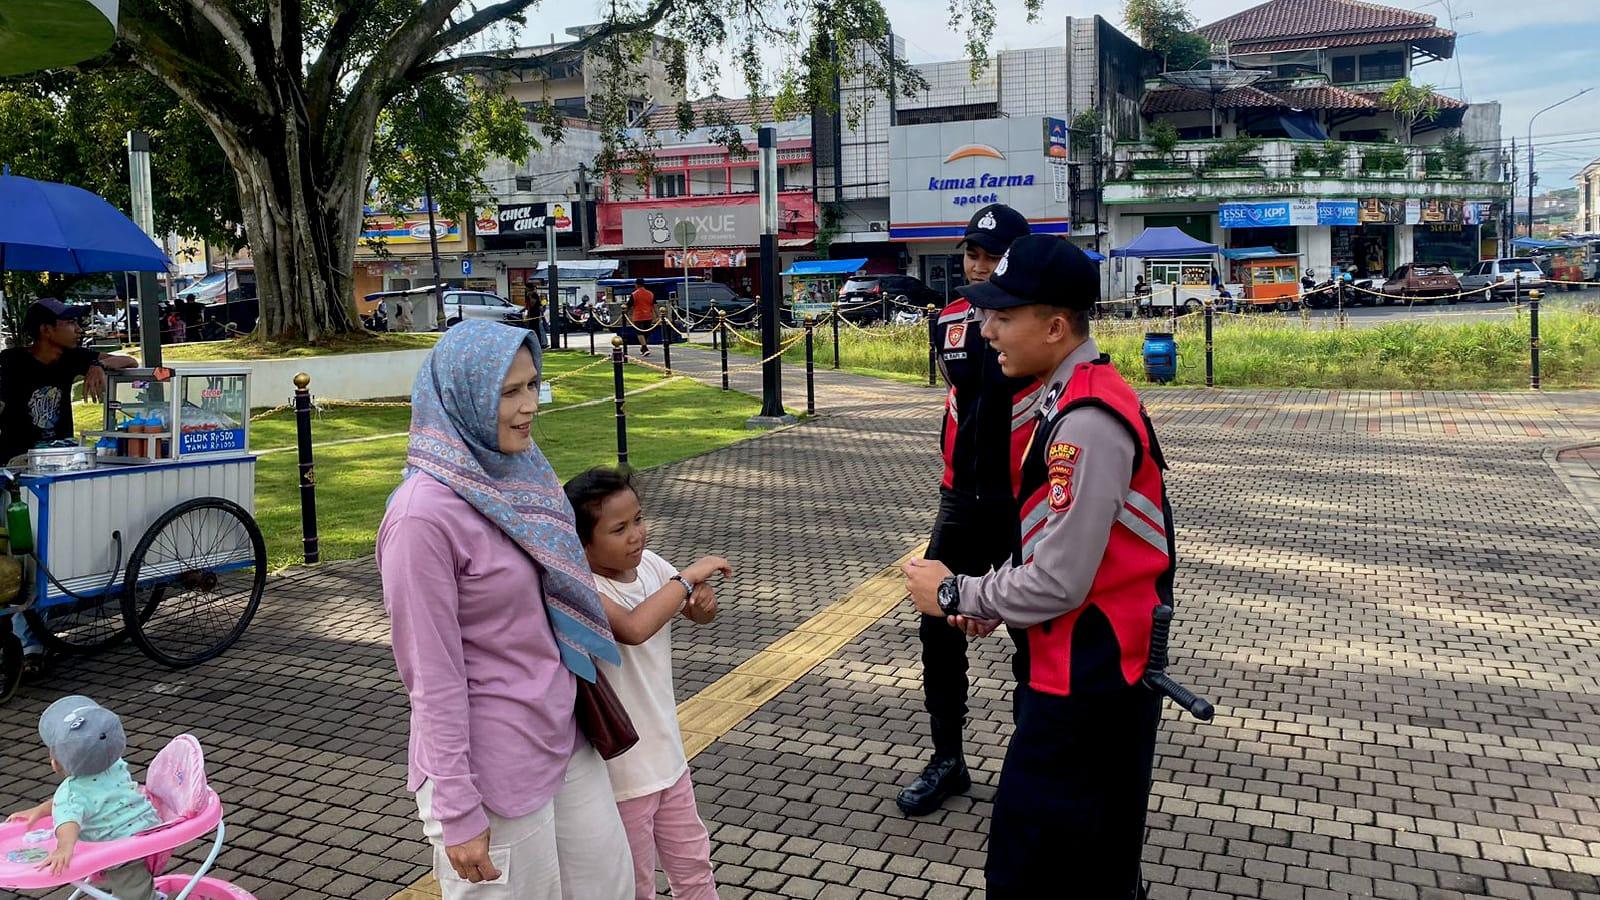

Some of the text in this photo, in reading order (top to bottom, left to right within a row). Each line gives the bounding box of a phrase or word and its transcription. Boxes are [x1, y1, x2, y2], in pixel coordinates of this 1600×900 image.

[928, 176, 975, 191] kimia
[980, 172, 1035, 188] farma
[953, 192, 997, 207] apotek
[500, 206, 532, 222] CHICK
[1223, 207, 1286, 219] ESSE KPP
[1319, 206, 1334, 216] ESSE
[1342, 207, 1356, 217] KPP
[514, 216, 546, 231] CHICK
[462, 261, 470, 273] P
